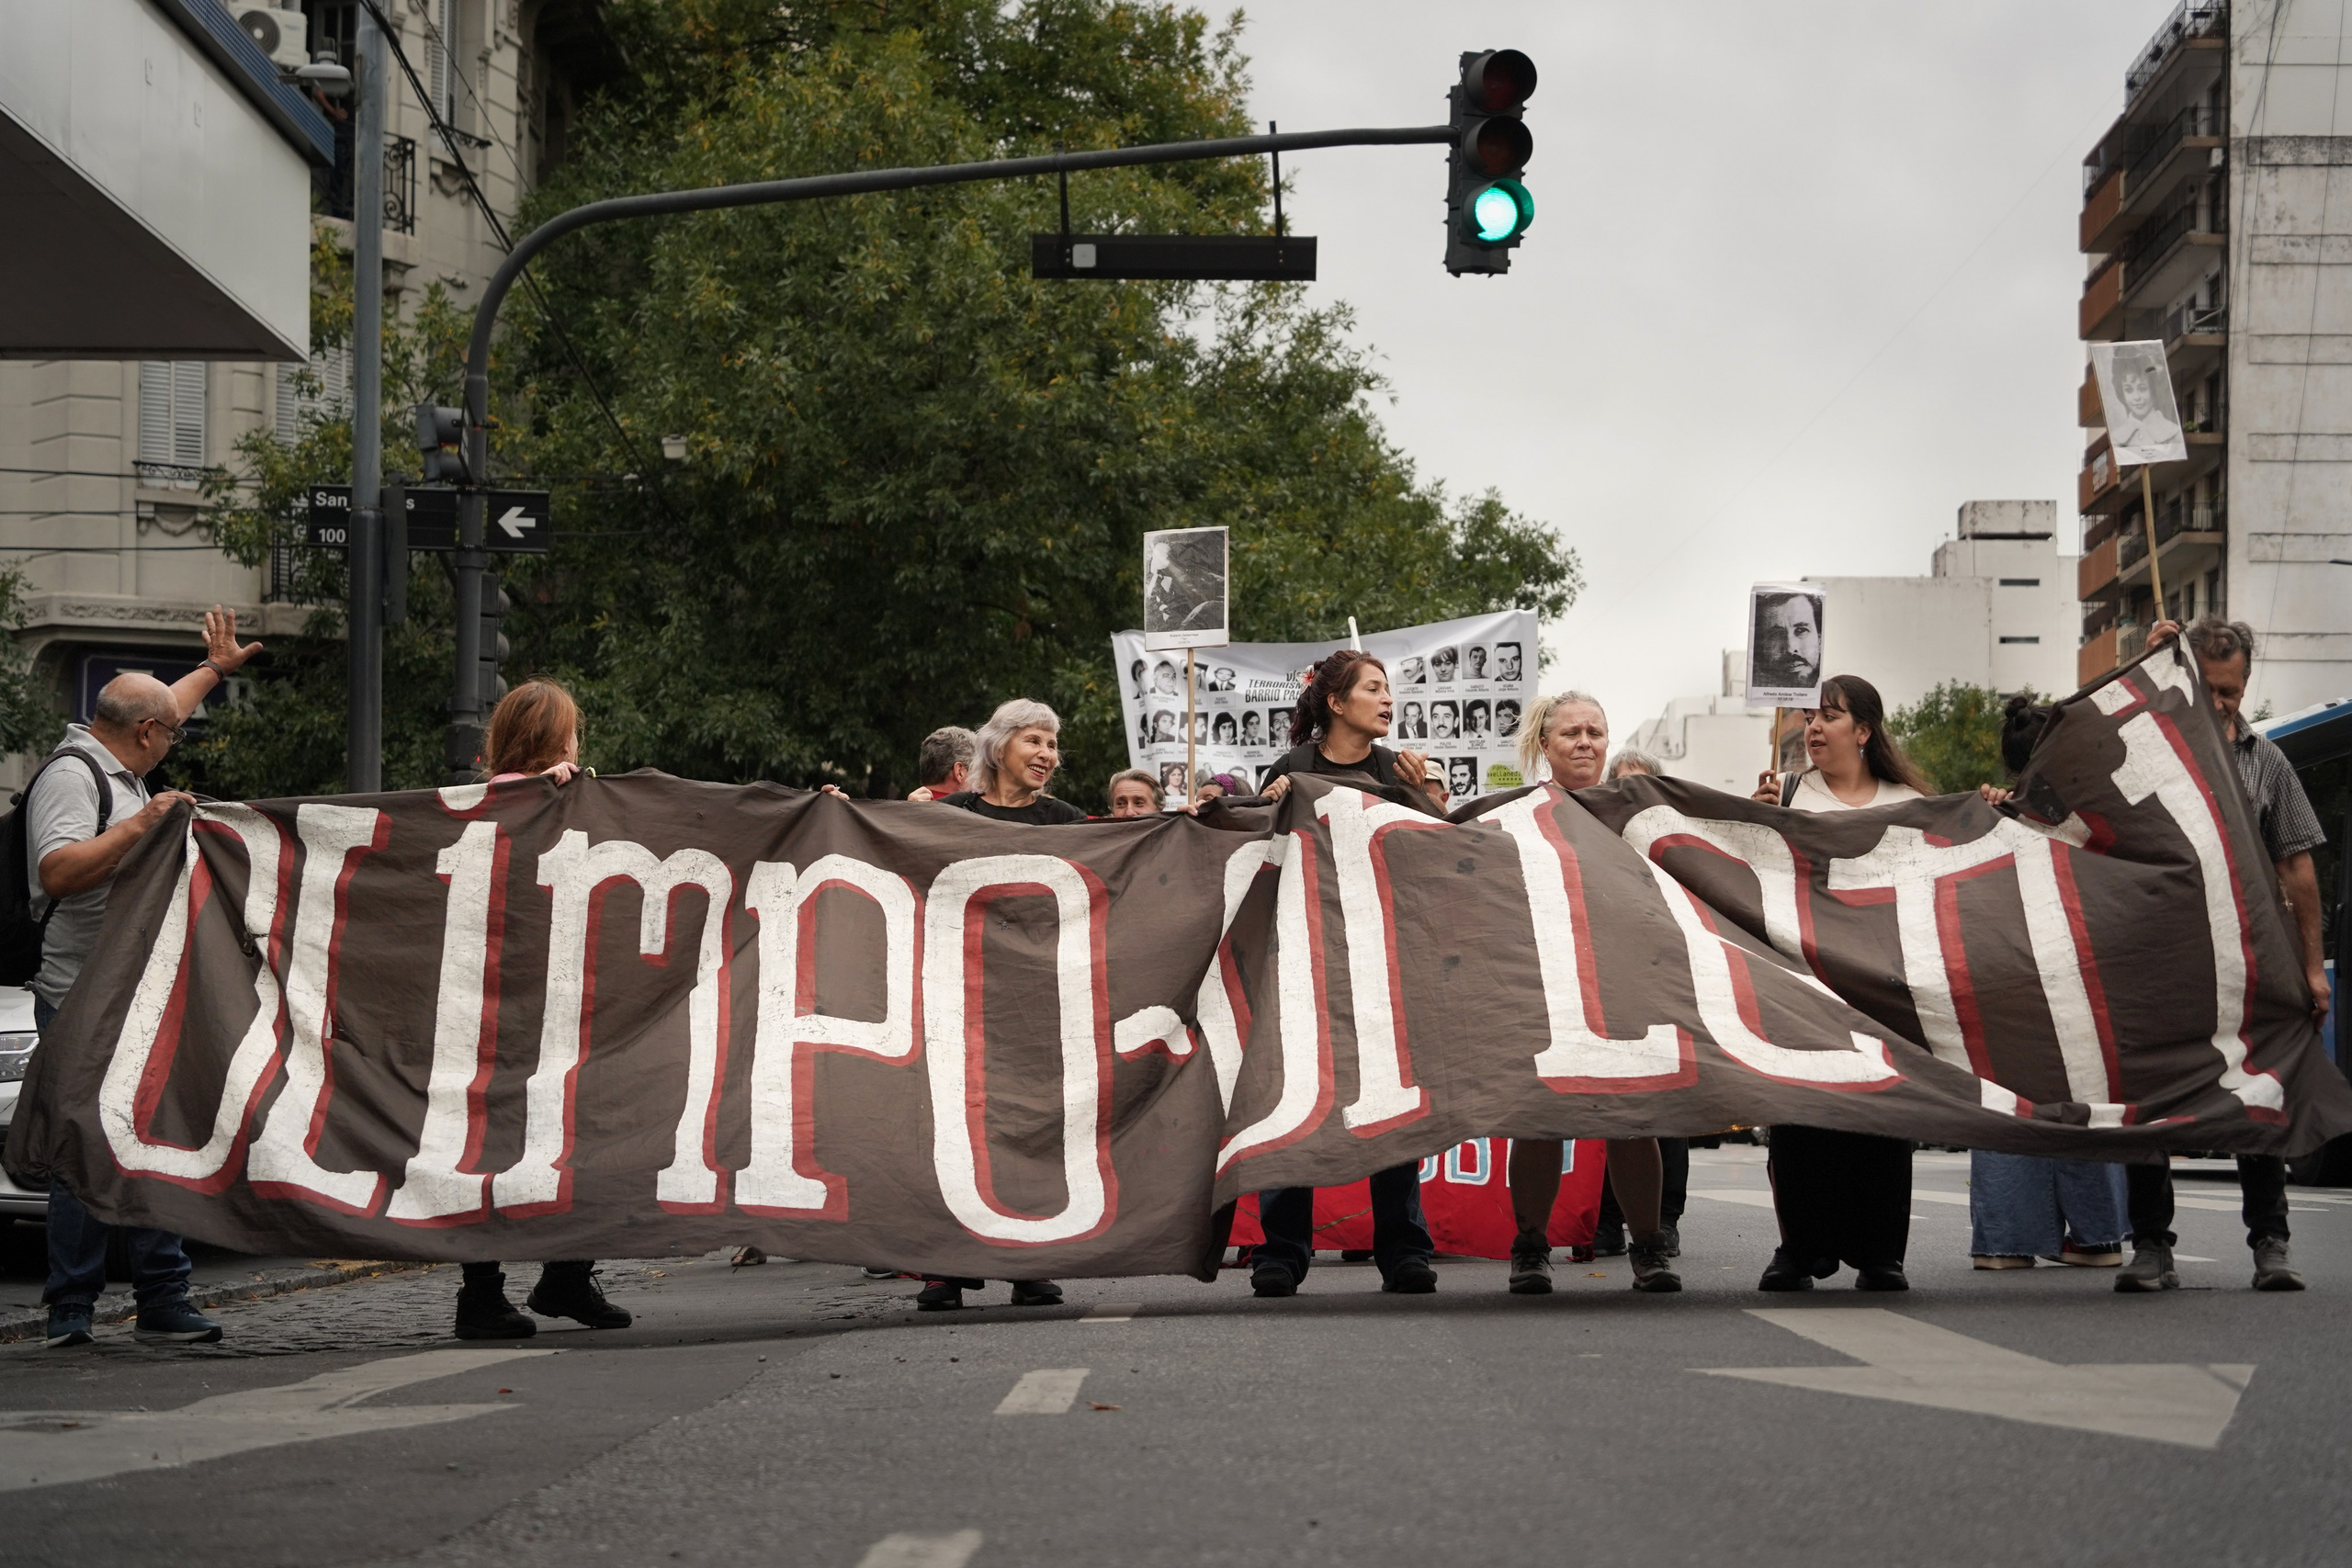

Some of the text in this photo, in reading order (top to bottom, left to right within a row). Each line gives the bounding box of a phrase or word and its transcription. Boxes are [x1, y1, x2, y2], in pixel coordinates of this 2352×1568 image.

[315, 491, 347, 507] San
[319, 528, 345, 544] 100
[1249, 679, 1301, 689] TERRORISM
[1245, 689, 1301, 703] BARRIO PAR
